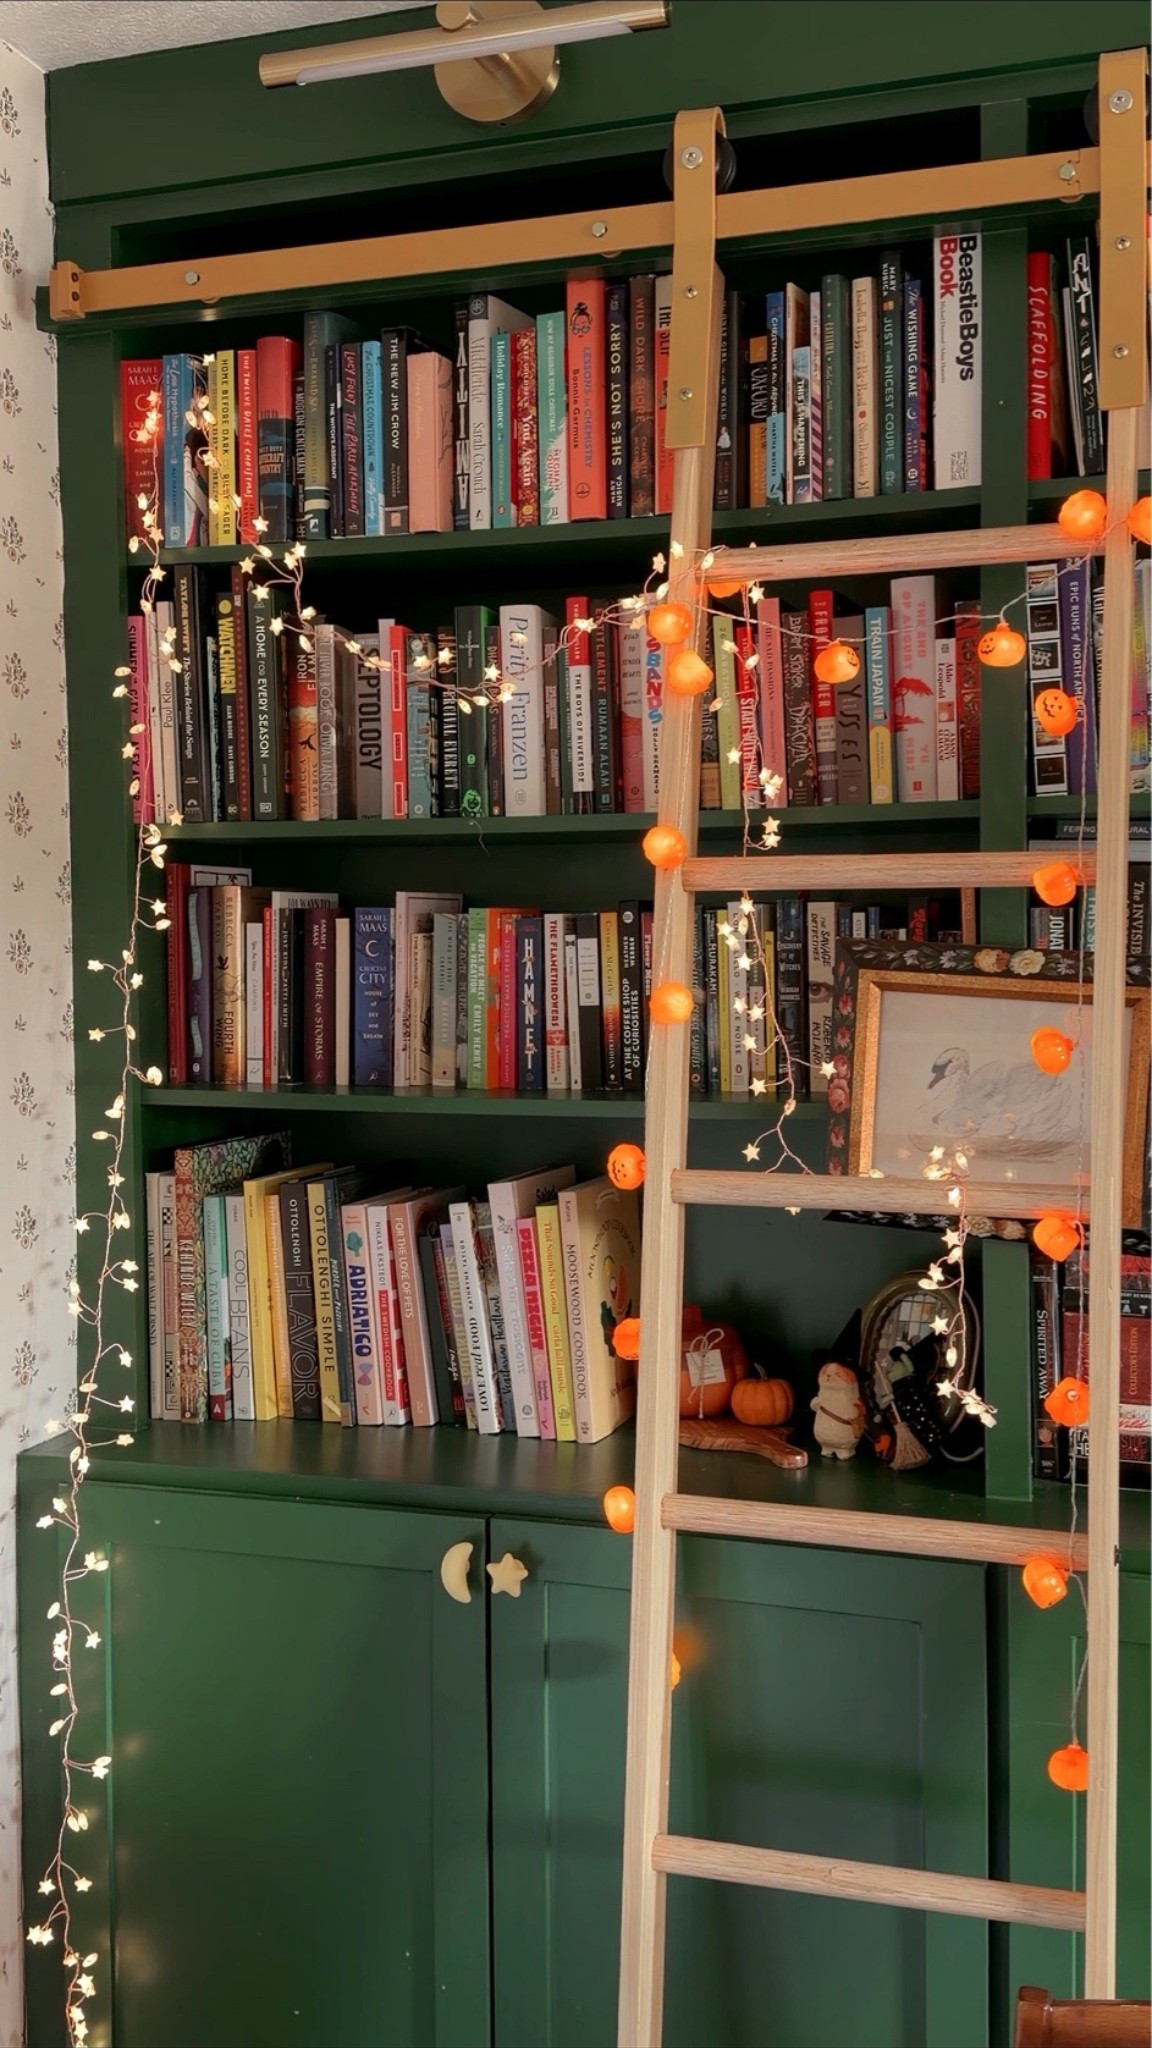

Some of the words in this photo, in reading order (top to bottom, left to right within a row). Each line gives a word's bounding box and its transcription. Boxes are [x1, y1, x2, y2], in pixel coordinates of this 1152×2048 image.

[939, 238, 958, 298] Book
[635, 297, 644, 331] WILD
[884, 317, 894, 347] JUST
[390, 338, 398, 361] THE
[610, 322, 621, 374] SORRY
[636, 336, 646, 372] DARK
[908, 309, 918, 362] WISHING
[1028, 286, 1048, 420] SCAFFOLDING
[221, 359, 229, 386] HOME
[344, 351, 356, 375] LUCY
[390, 362, 399, 390] NEW
[496, 340, 506, 380] Holiday
[583, 346, 593, 394] LESSONS
[128, 376, 158, 385] MAAS
[346, 376, 357, 406] FOLEY
[611, 383, 622, 415] NOT
[884, 364, 894, 409] NICEST
[908, 364, 918, 397] GAME
[169, 388, 179, 437] Hypothesis
[221, 391, 229, 425] BEFORE
[391, 393, 399, 412] JIM
[497, 382, 505, 429] Romance
[636, 377, 647, 424] SHORE
[391, 413, 400, 450] CROW
[472, 422, 485, 447] Sarah
[584, 407, 593, 469] CHEMISTRY
[611, 421, 622, 466] SHE'S
[884, 414, 895, 461] COUPLE
[473, 449, 488, 495] Crouch
[520, 445, 533, 487] Again
[222, 473, 230, 500] RILEY
[348, 466, 360, 515] APARTMENT
[223, 505, 231, 535] SAGER
[180, 577, 189, 618] TAYLOR
[1069, 581, 1080, 603] EPIC
[182, 619, 190, 653] SWIFT
[1070, 605, 1080, 632] RUNS
[217, 617, 236, 694] WATCHMEN
[256, 626, 266, 658] HOME
[869, 617, 882, 661] TRAIN
[903, 614, 913, 671] AUGUST
[917, 629, 927, 658] END
[297, 654, 308, 683] IRON
[944, 662, 953, 684] Aldo
[1072, 643, 1082, 678] NORTH
[164, 681, 172, 702] Klee
[257, 678, 268, 713] EVERY
[645, 636, 662, 725] SBANDS
[871, 663, 885, 707] JAPAN
[937, 662, 946, 699] Leopold
[164, 703, 173, 728] Paul
[185, 697, 193, 723] Behind
[357, 647, 382, 770] SEPTOLOGY
[597, 698, 608, 750] RUMAAN
[838, 684, 862, 762] YSSES
[258, 714, 269, 758] SEASON
[512, 691, 531, 782] Franzen
[444, 739, 458, 790] EVERETT
[576, 734, 584, 783] RIVERSIDE
[600, 752, 609, 787] ALAM
[300, 758, 308, 811] REBECCA
[1133, 881, 1145, 901] The
[225, 896, 234, 948] REBECCA
[359, 922, 387, 932] MAAS
[549, 920, 557, 939] THE
[605, 920, 613, 952] Cormac
[811, 913, 820, 962] DETECTIVES
[820, 928, 832, 968] SAVAGE
[314, 962, 323, 999] EMPIRE
[359, 973, 387, 985] CITY
[470, 954, 478, 993] VACATION
[550, 942, 560, 1027] FLAMETHROWERS
[606, 956, 615, 996] McCarthy
[708, 943, 717, 995] MURAKAMI
[522, 938, 538, 1069] HAMNET
[622, 978, 630, 1006] SHOP
[215, 1017, 224, 1048] WING
[224, 1011, 234, 1055] FOURTH
[473, 1004, 482, 1034] EMILY
[623, 1007, 632, 1045] COFFEE
[631, 990, 640, 1052] CURIOSITIES
[314, 1017, 324, 1060] STORMS
[473, 1037, 481, 1068] HENRY
[608, 1033, 616, 1069] MERIDIAN
[624, 1047, 632, 1066] THE
[812, 1021, 823, 1066] BOLAÑO
[624, 1067, 633, 1080] AT
[633, 1054, 641, 1068] OF
[289, 1199, 302, 1268] OTTOLENGHI
[375, 1221, 384, 1251] NIKLAS
[395, 1217, 405, 1237] FOR
[543, 1222, 553, 1242] That
[180, 1239, 195, 1286] KEHINDE
[233, 1249, 247, 1293] COOL
[314, 1204, 331, 1309] OTTOLENGHI
[377, 1252, 386, 1286] EKSTEDT
[400, 1256, 411, 1281] LOVE
[519, 1227, 538, 1286] PIZZA
[545, 1243, 556, 1276] Sounds
[208, 1281, 219, 1322] TASTE
[403, 1281, 411, 1295] OF
[549, 1291, 560, 1315] Good
[566, 1244, 582, 1326] MOOSEWOOD
[180, 1291, 196, 1328] WILEY
[404, 1295, 414, 1319] PETS
[525, 1290, 544, 1351] NIGHT
[211, 1328, 220, 1346] OF
[230, 1299, 250, 1379] BEANS
[286, 1271, 318, 1401] FLAVOR
[321, 1316, 336, 1373] SIMPLE
[381, 1311, 391, 1347] SWEDISH
[469, 1316, 482, 1350] FOOD
[1036, 1310, 1048, 1365] SPIRITED
[1129, 1327, 1138, 1353] EDITION
[211, 1351, 222, 1388] CUBA
[384, 1349, 394, 1398] COOKBOOK
[472, 1351, 487, 1380] real
[497, 1344, 512, 1396] Vegetarian
[573, 1331, 588, 1400] COOKBOOK
[1038, 1367, 1050, 1400] AWAY
[474, 1381, 488, 1413] LOVE
